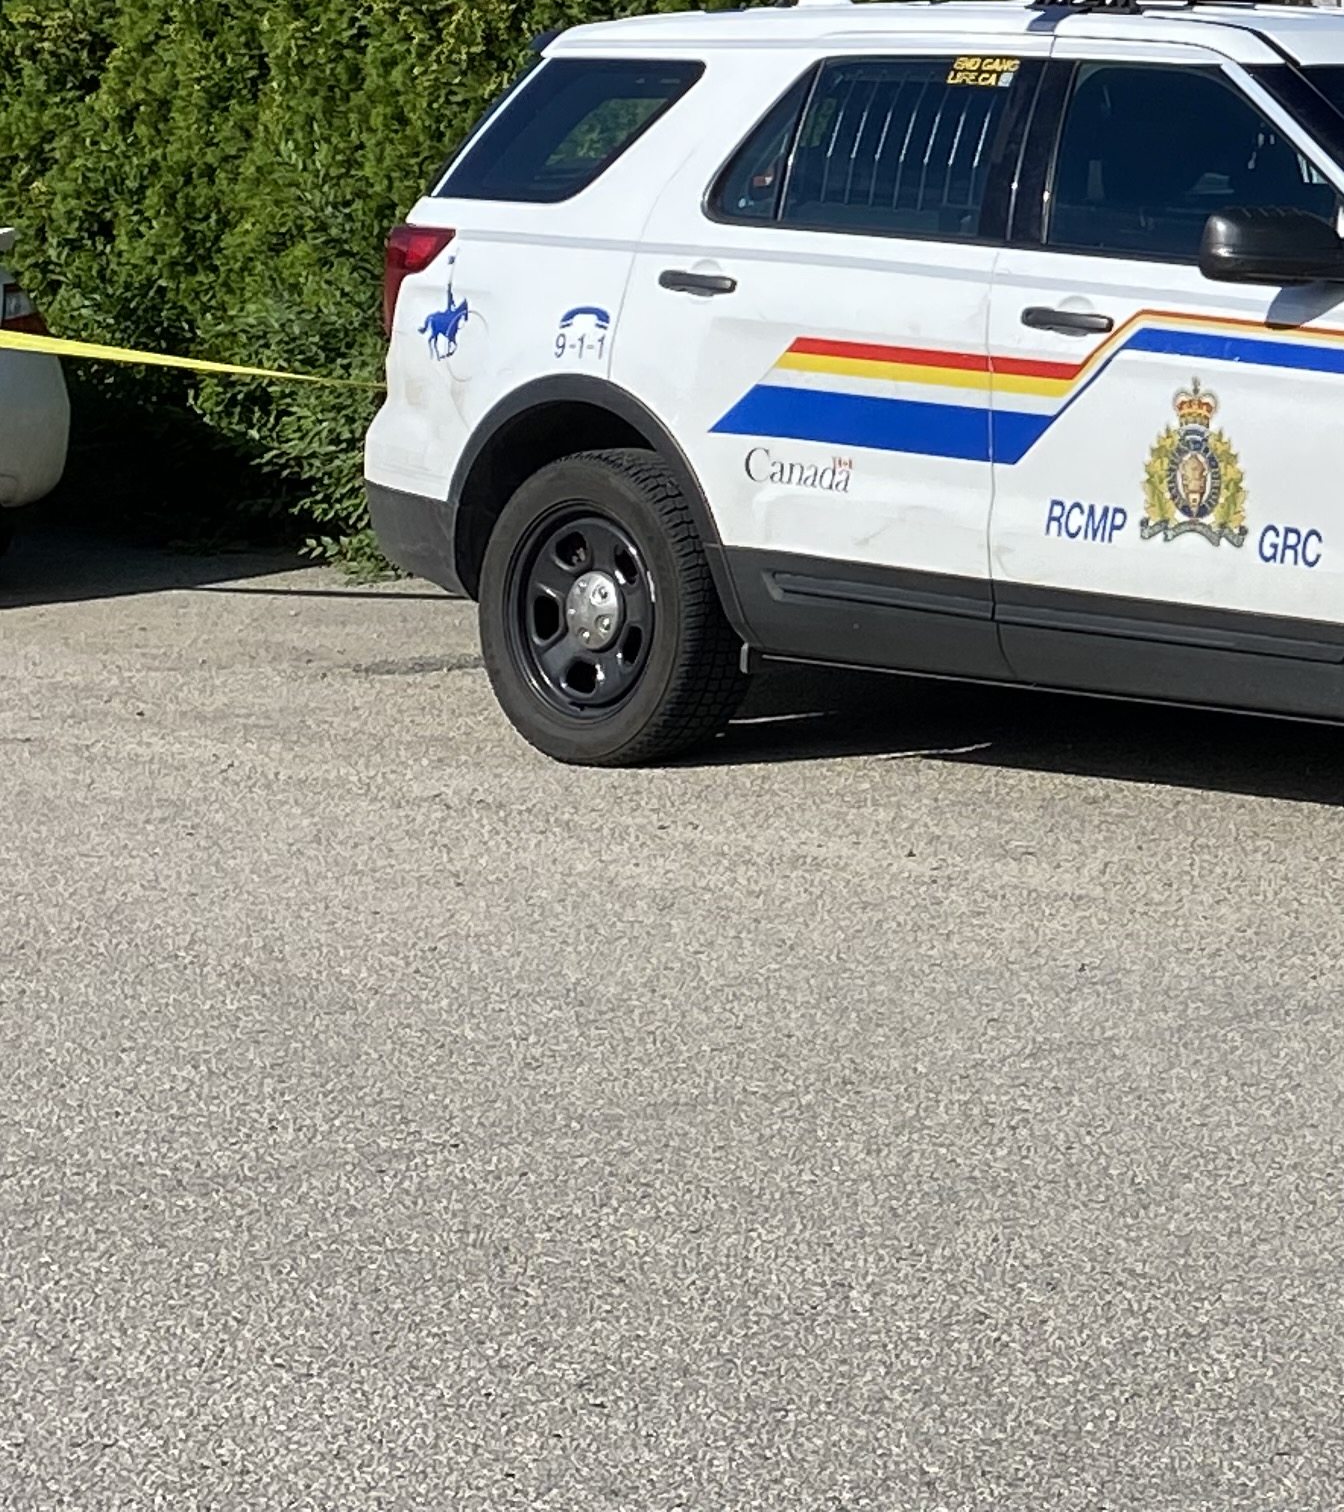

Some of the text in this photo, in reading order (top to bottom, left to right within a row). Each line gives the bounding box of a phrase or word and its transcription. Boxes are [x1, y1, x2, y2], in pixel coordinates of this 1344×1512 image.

[554, 333, 606, 360] 9-1-1
[744, 447, 851, 493] Canada
[1045, 499, 1128, 543] RCMP
[1258, 524, 1323, 568] GRC
